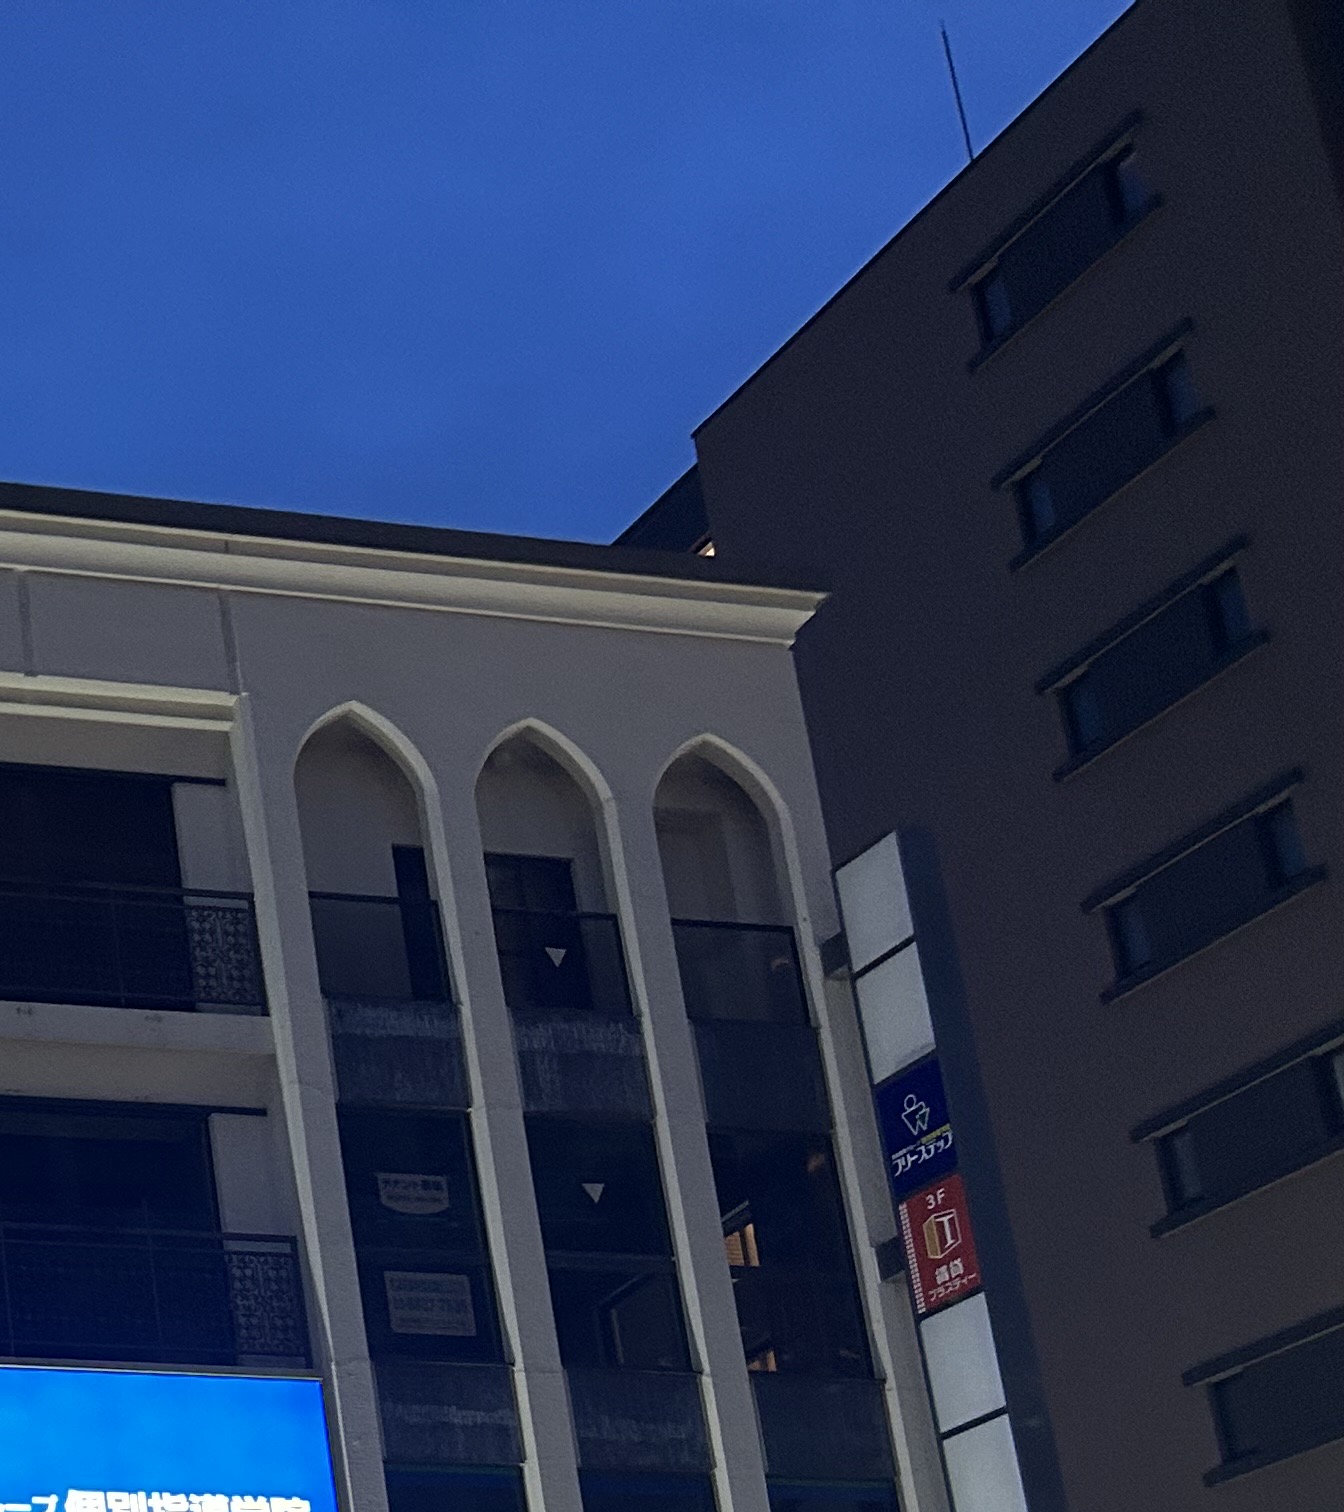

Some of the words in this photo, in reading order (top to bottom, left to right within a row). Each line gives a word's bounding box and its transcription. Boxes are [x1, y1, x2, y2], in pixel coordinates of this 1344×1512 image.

[892, 1131, 954, 1177] フリーステップ
[926, 1188, 946, 1210] 3F
[928, 1272, 977, 1301] プラスティー
